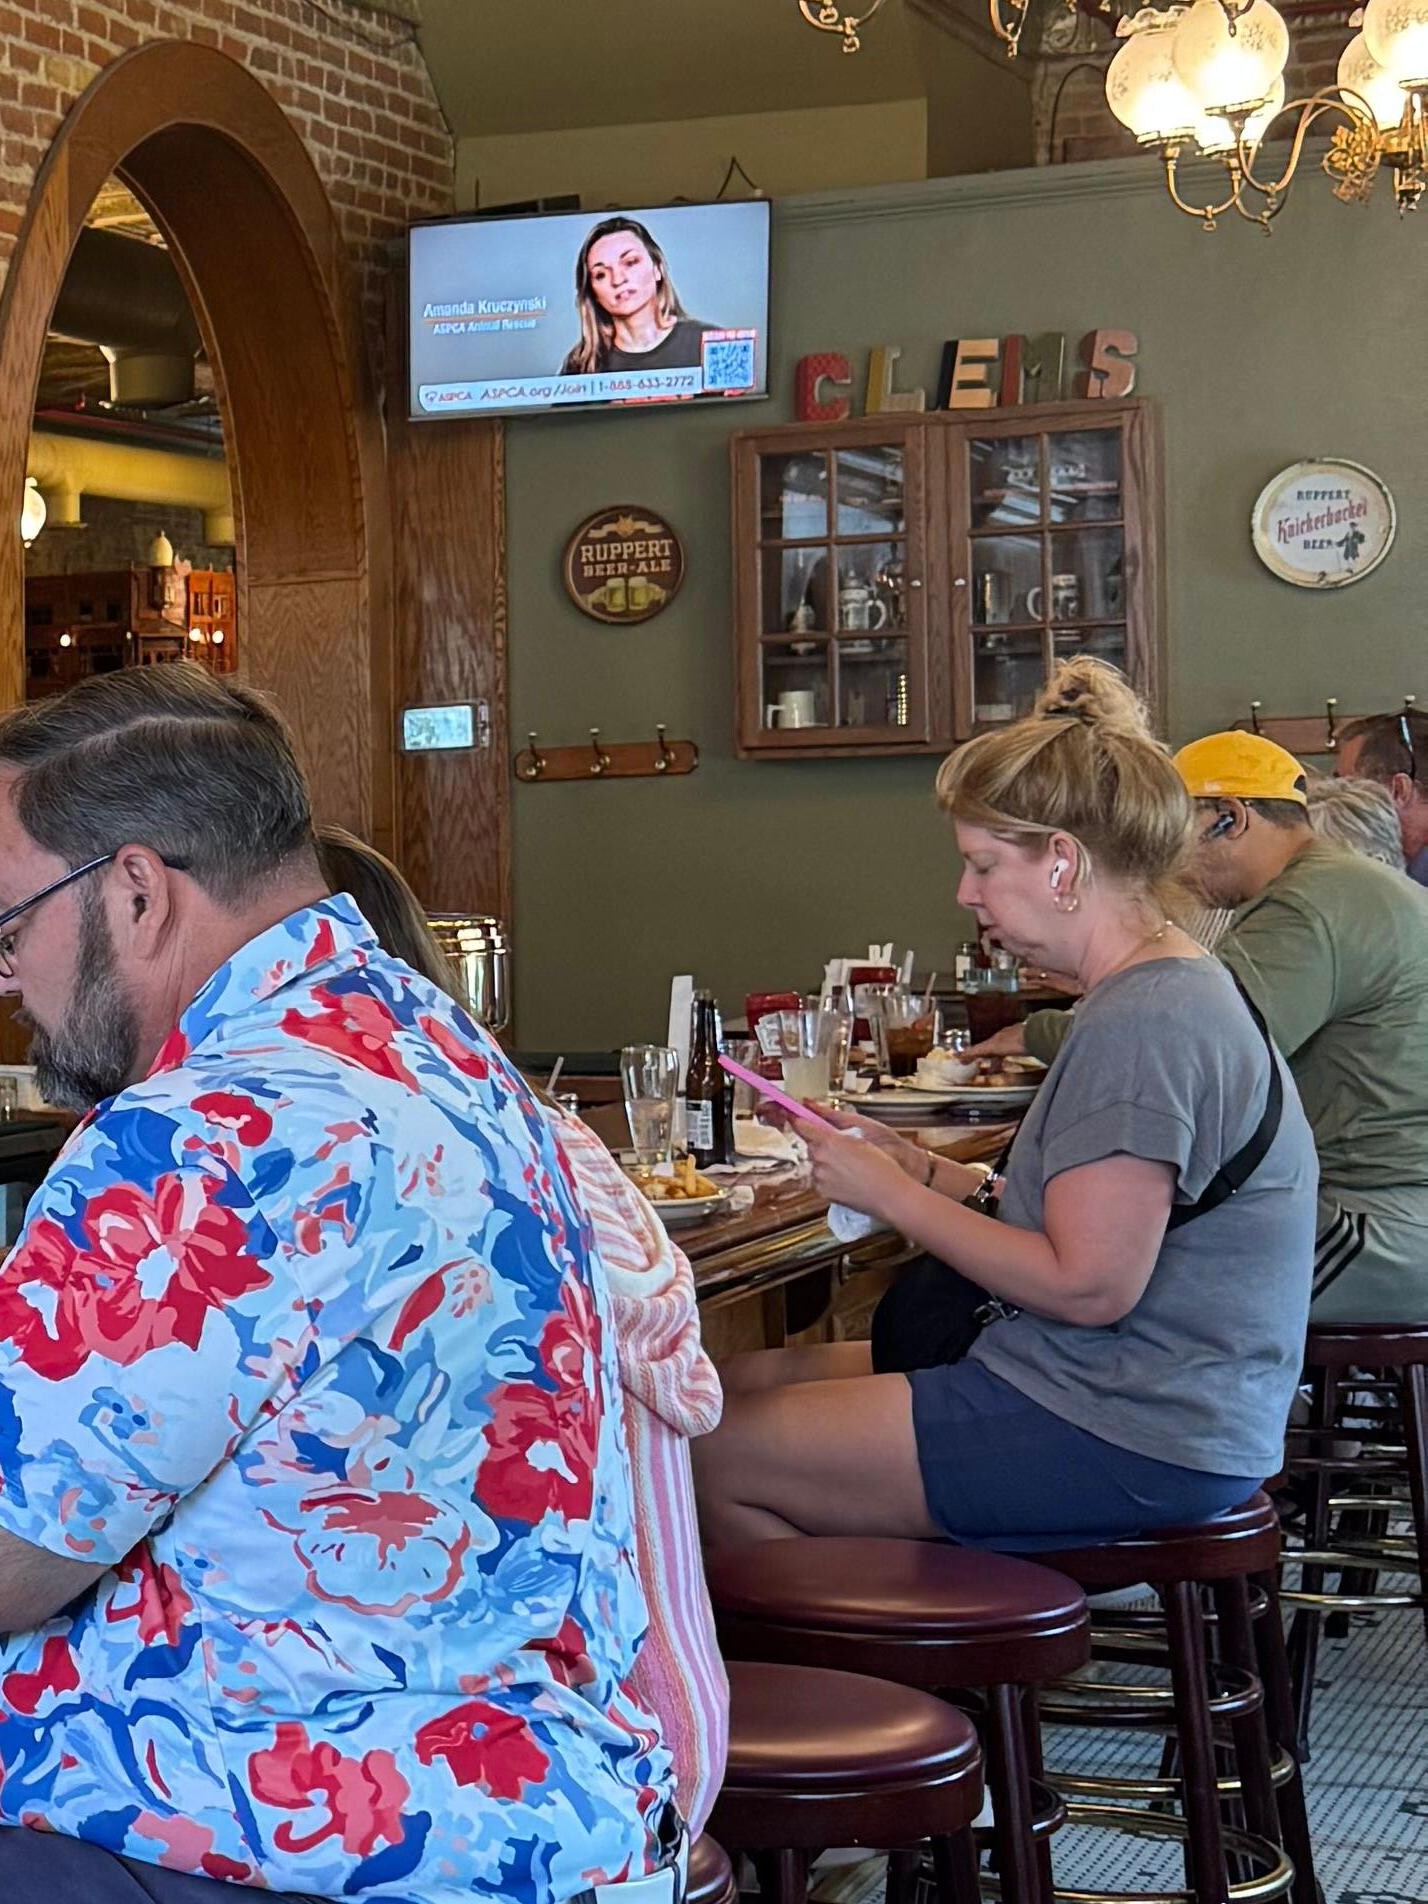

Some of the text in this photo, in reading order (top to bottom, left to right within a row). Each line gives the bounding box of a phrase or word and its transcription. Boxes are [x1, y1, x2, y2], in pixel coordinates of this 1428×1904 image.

[423, 301, 474, 318] Amanda
[796, 329, 1138, 422] CLEMS
[1296, 489, 1350, 501] RUPPERT
[580, 539, 673, 563] RUPPERT
